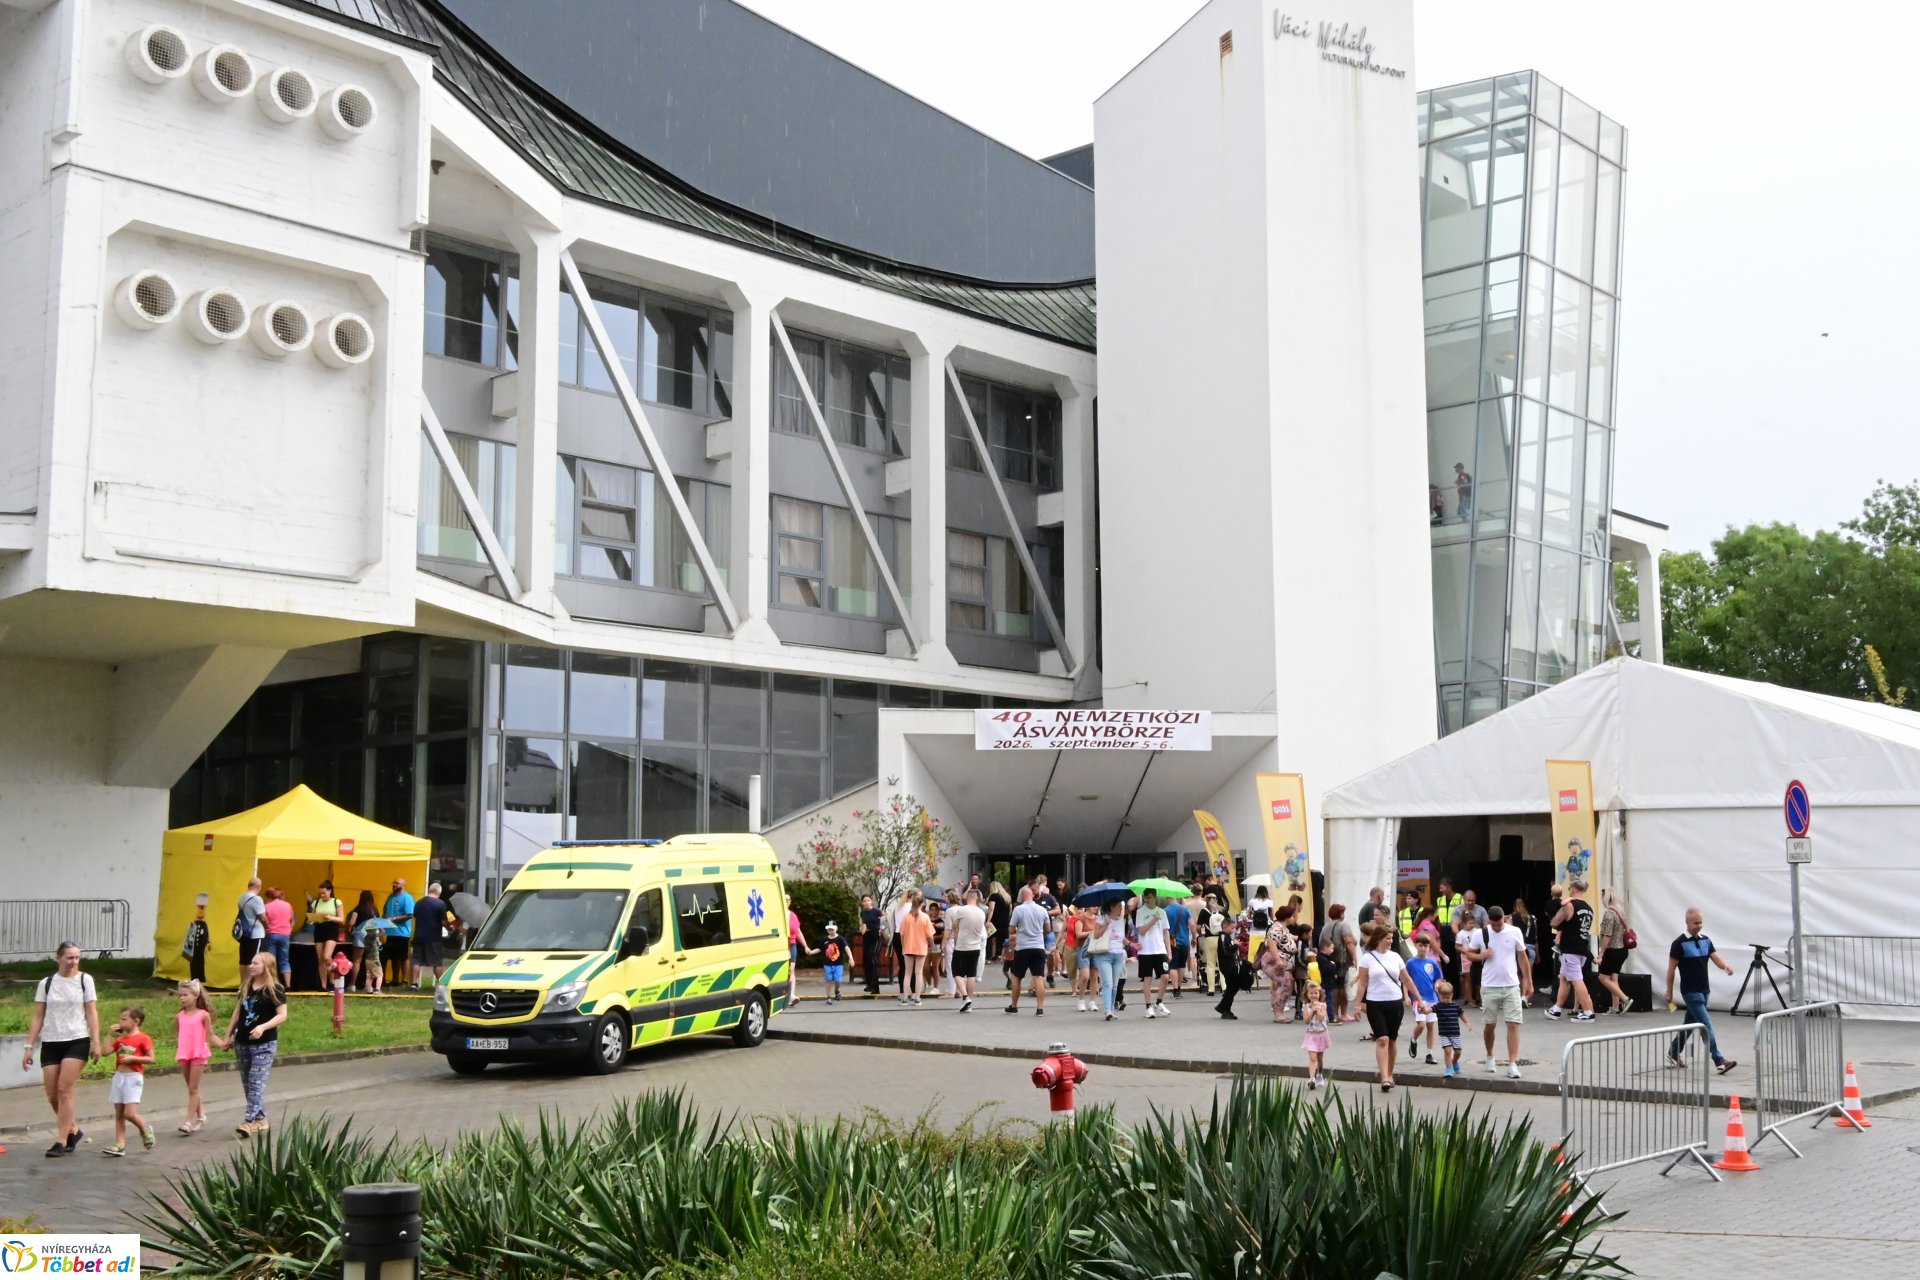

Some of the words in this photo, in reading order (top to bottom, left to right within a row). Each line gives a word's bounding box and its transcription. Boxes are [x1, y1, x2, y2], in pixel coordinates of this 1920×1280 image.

[1055, 709, 1200, 724] NEMZETKÖZI
[1013, 722, 1176, 739] ÁSVÁNYBÖRZE
[993, 740, 1033, 749] 2026.
[1049, 739, 1139, 749] szeptember
